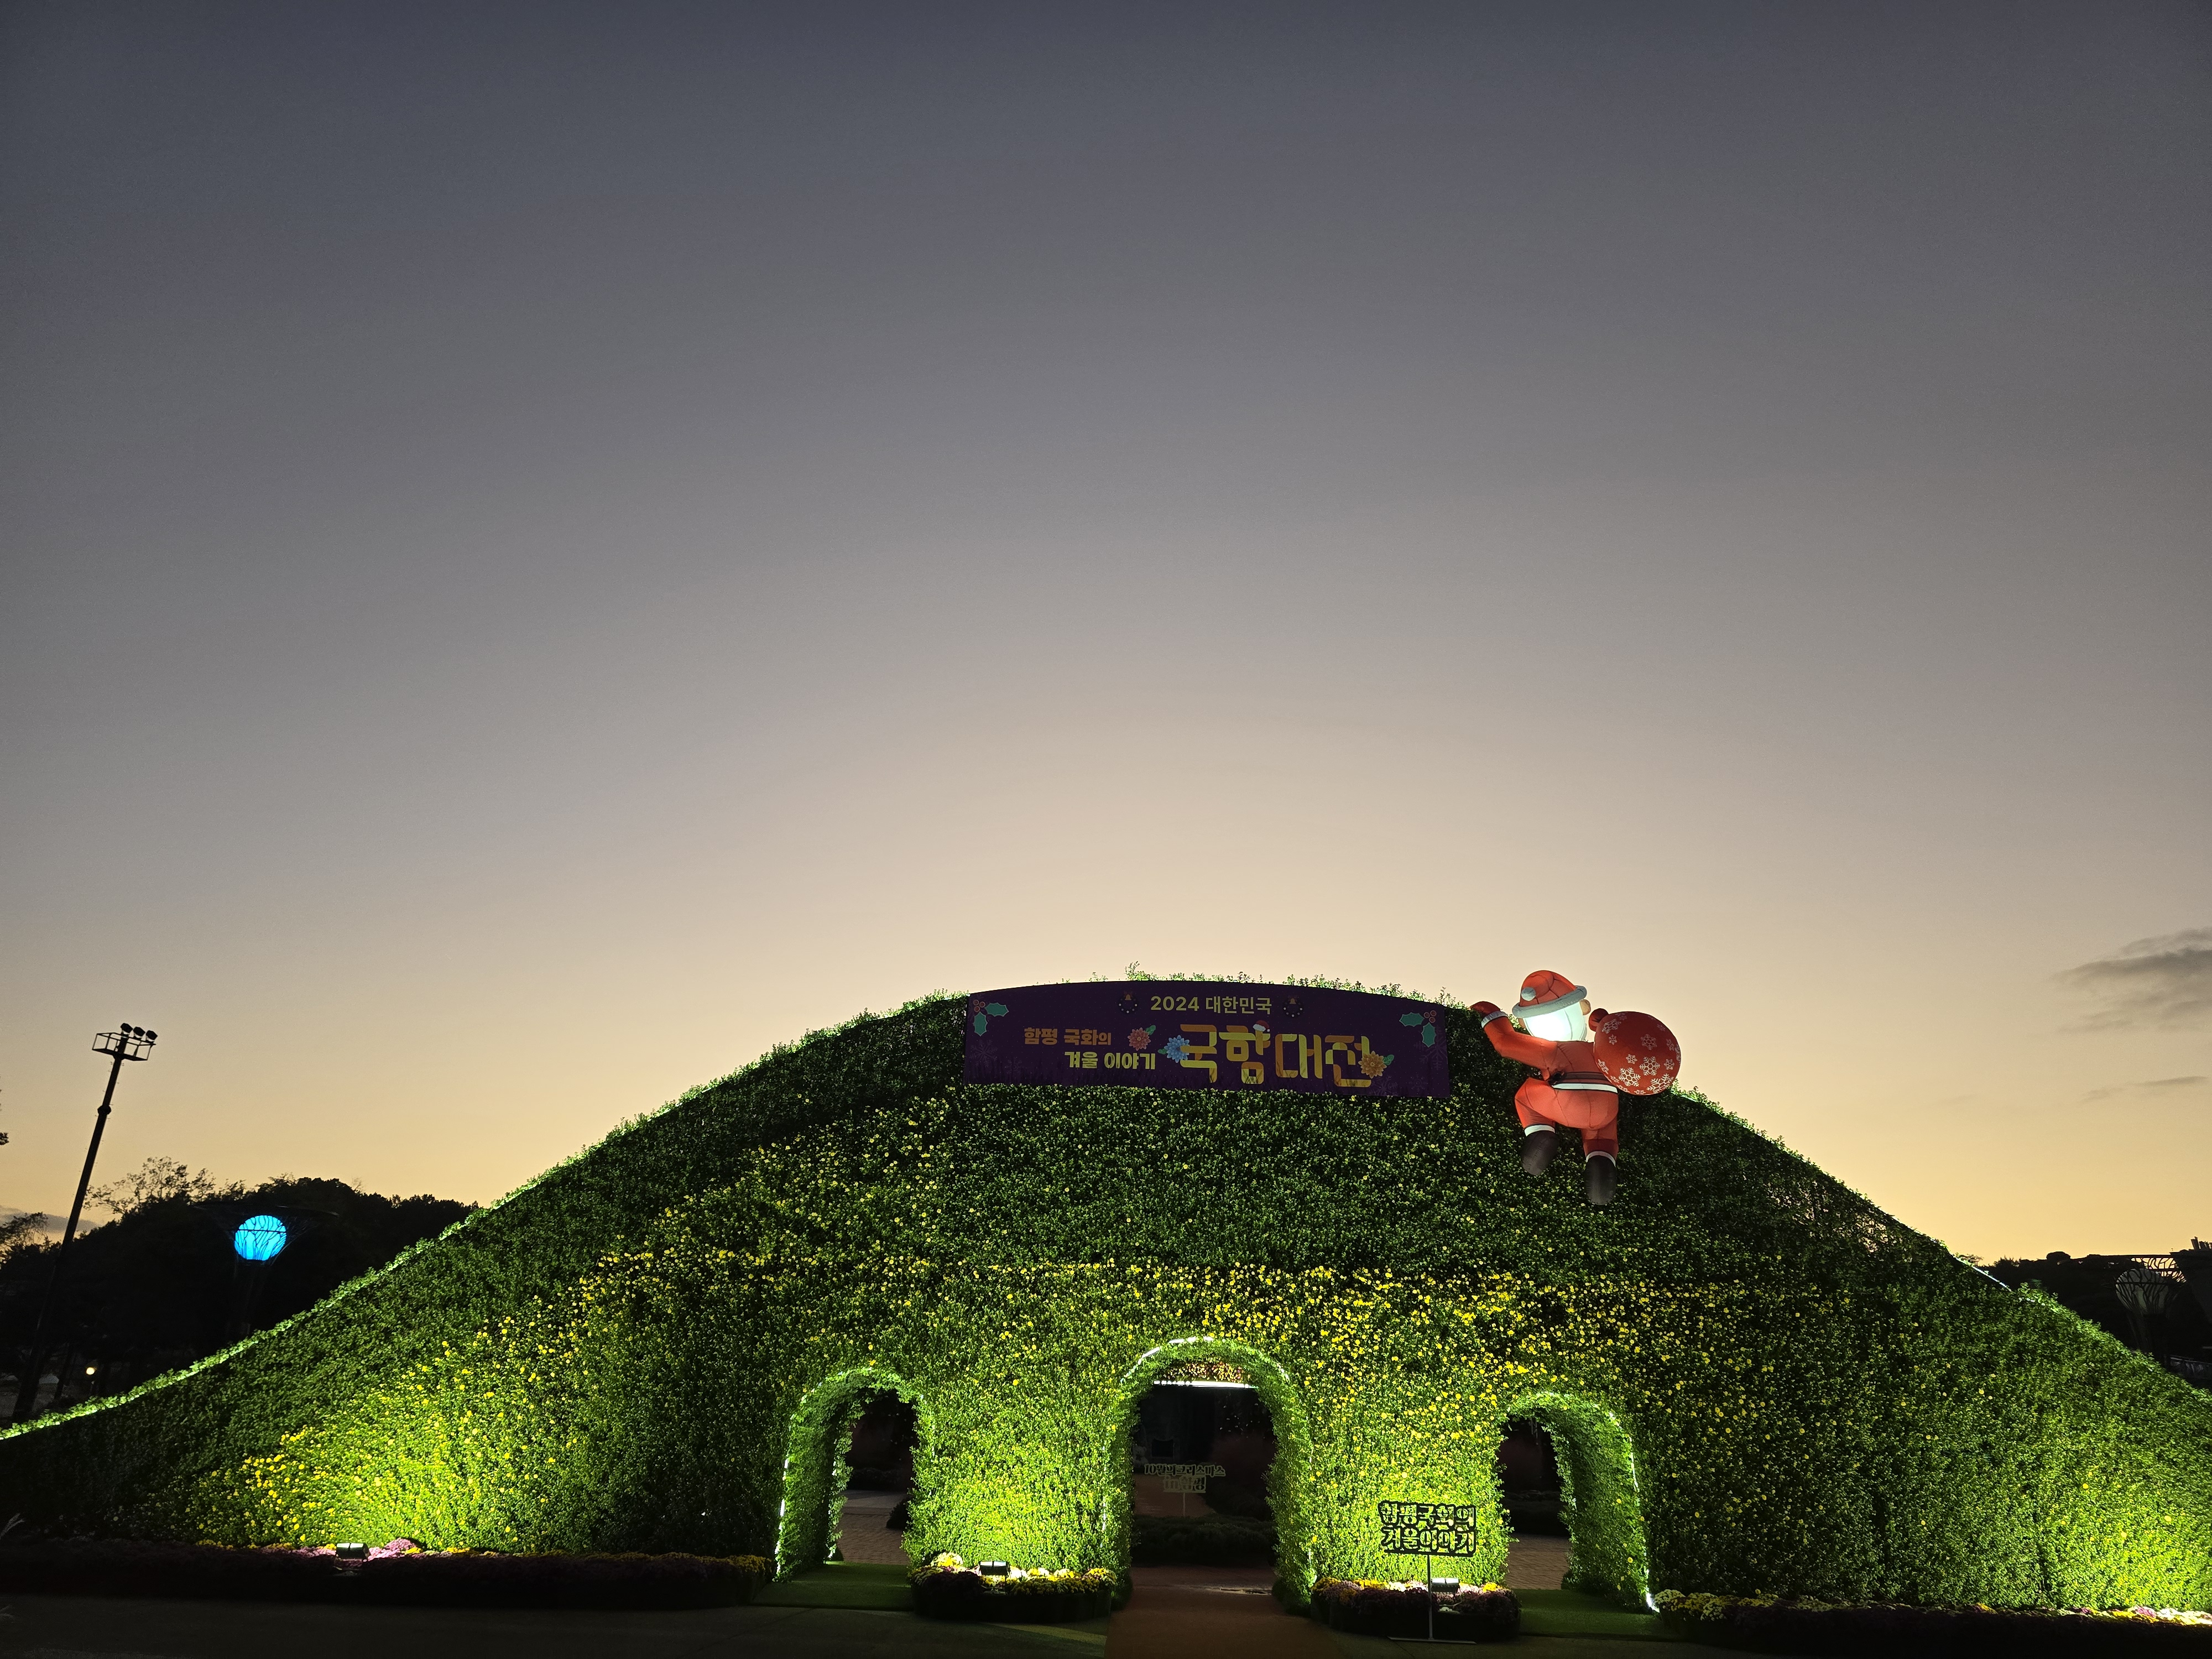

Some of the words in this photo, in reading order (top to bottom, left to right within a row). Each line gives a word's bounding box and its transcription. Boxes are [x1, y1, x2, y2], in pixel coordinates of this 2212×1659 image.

[1150, 996, 1200, 1011] 2024
[1206, 996, 1272, 1015] 대한민국
[1024, 1027, 1058, 1045] 함평
[1063, 1029, 1112, 1046] 국화의
[1064, 1051, 1098, 1069] 겨울
[1104, 1052, 1156, 1070] 이야기
[1180, 1023, 1373, 1088] 국향대전
